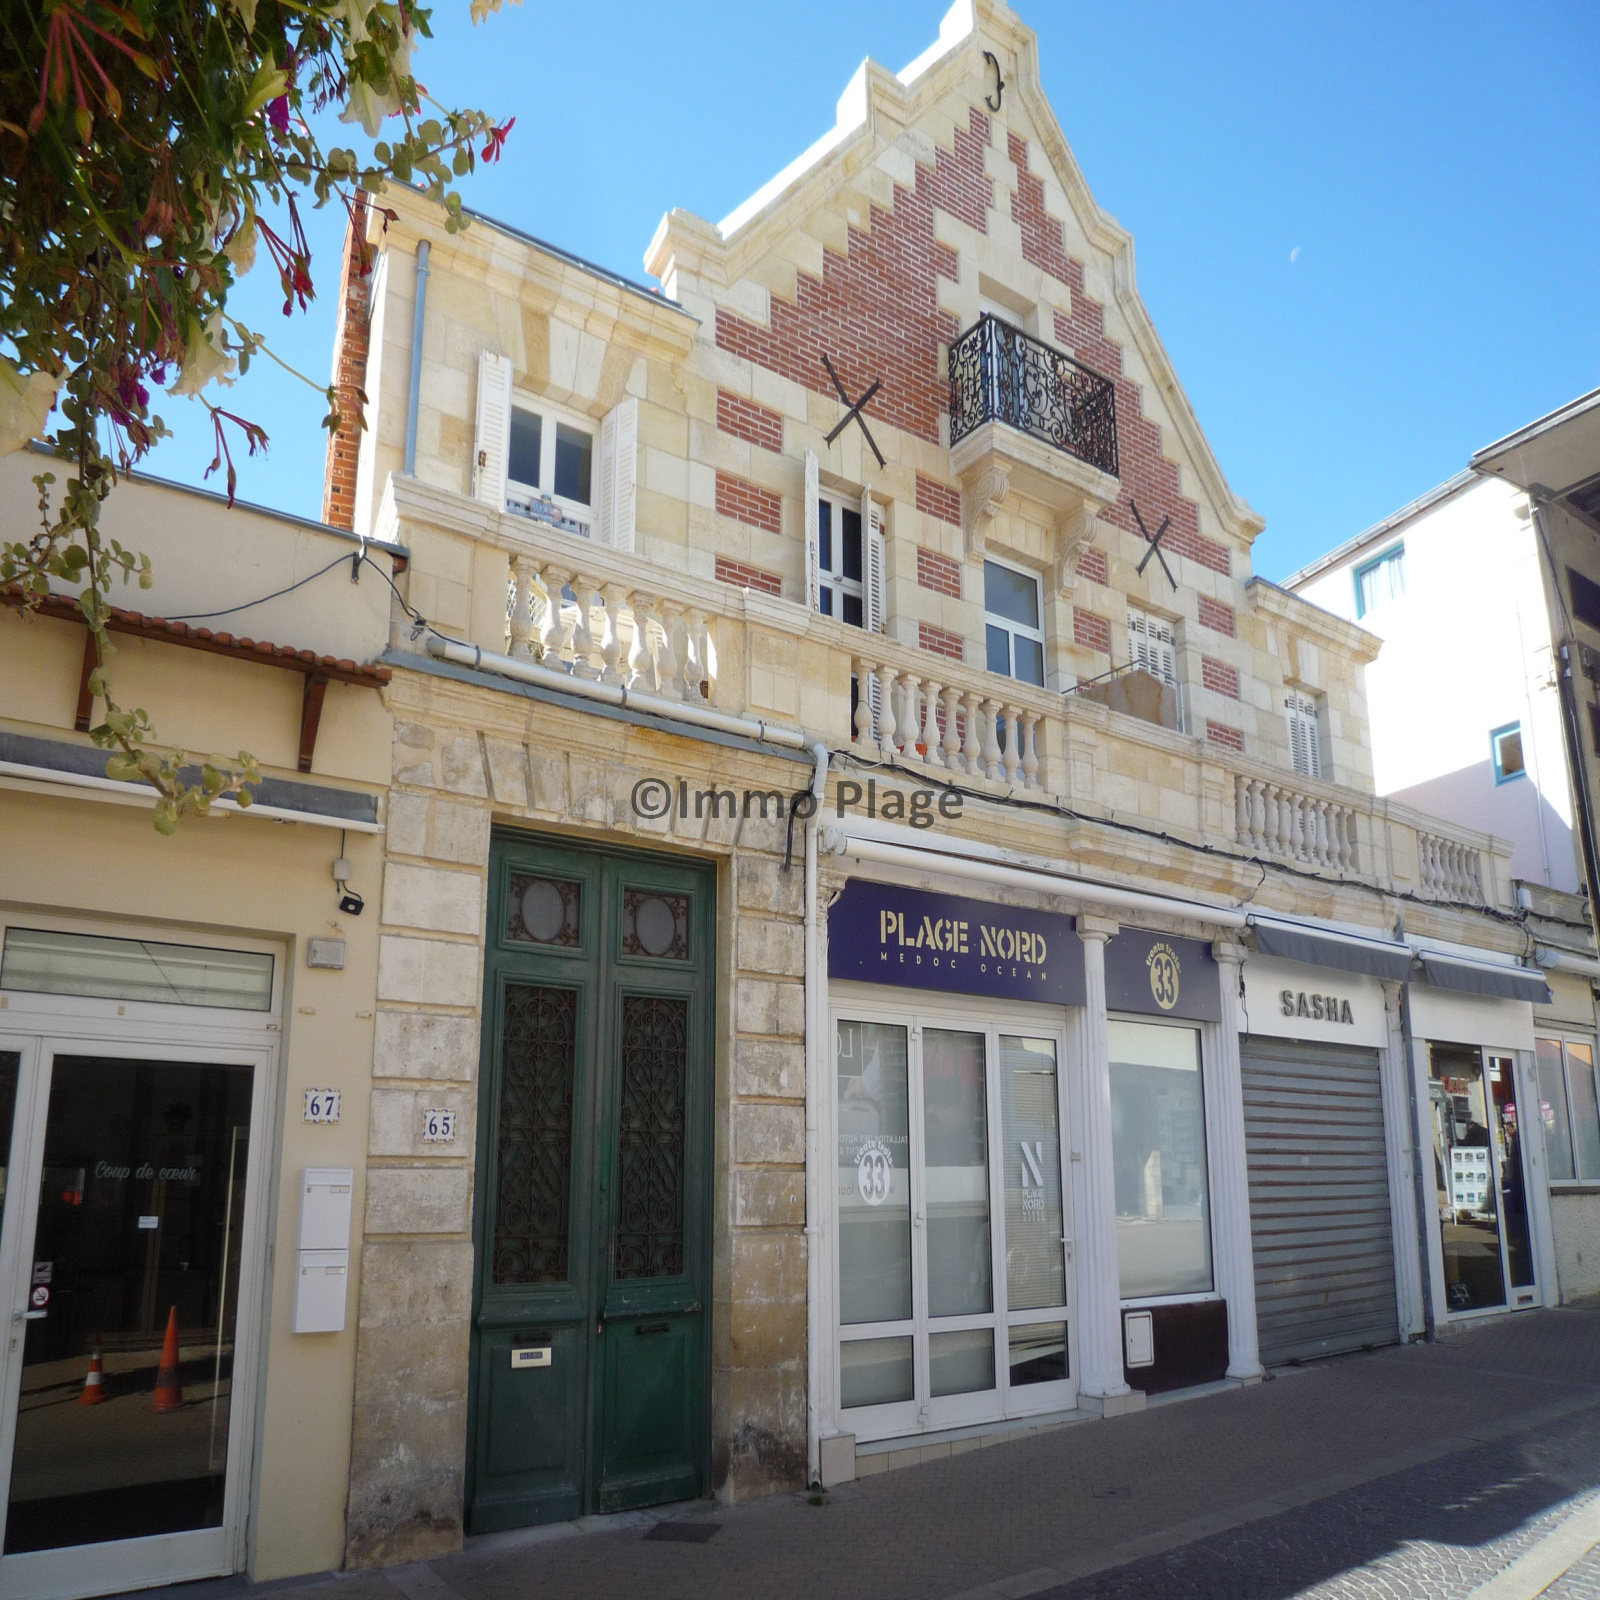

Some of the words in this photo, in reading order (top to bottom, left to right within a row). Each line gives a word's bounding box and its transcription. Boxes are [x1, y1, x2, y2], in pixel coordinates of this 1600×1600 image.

[880, 910, 969, 953] PLAGE
[980, 925, 1047, 965] NORD
[1146, 942, 1165, 966] trente
[880, 952, 956, 969] MEDOC
[980, 964, 1047, 981] OCEAN
[1154, 957, 1175, 1004] 33
[1282, 990, 1355, 1025] SASHA
[310, 1096, 335, 1116] 67
[428, 1116, 450, 1136] 65
[854, 1140, 876, 1164] trente
[95, 1160, 131, 1182] Coup
[135, 1162, 155, 1179] de
[864, 1154, 885, 1200] 33
[1022, 1188, 1044, 1198] PLAGE
[1022, 1199, 1045, 1210] NORD
